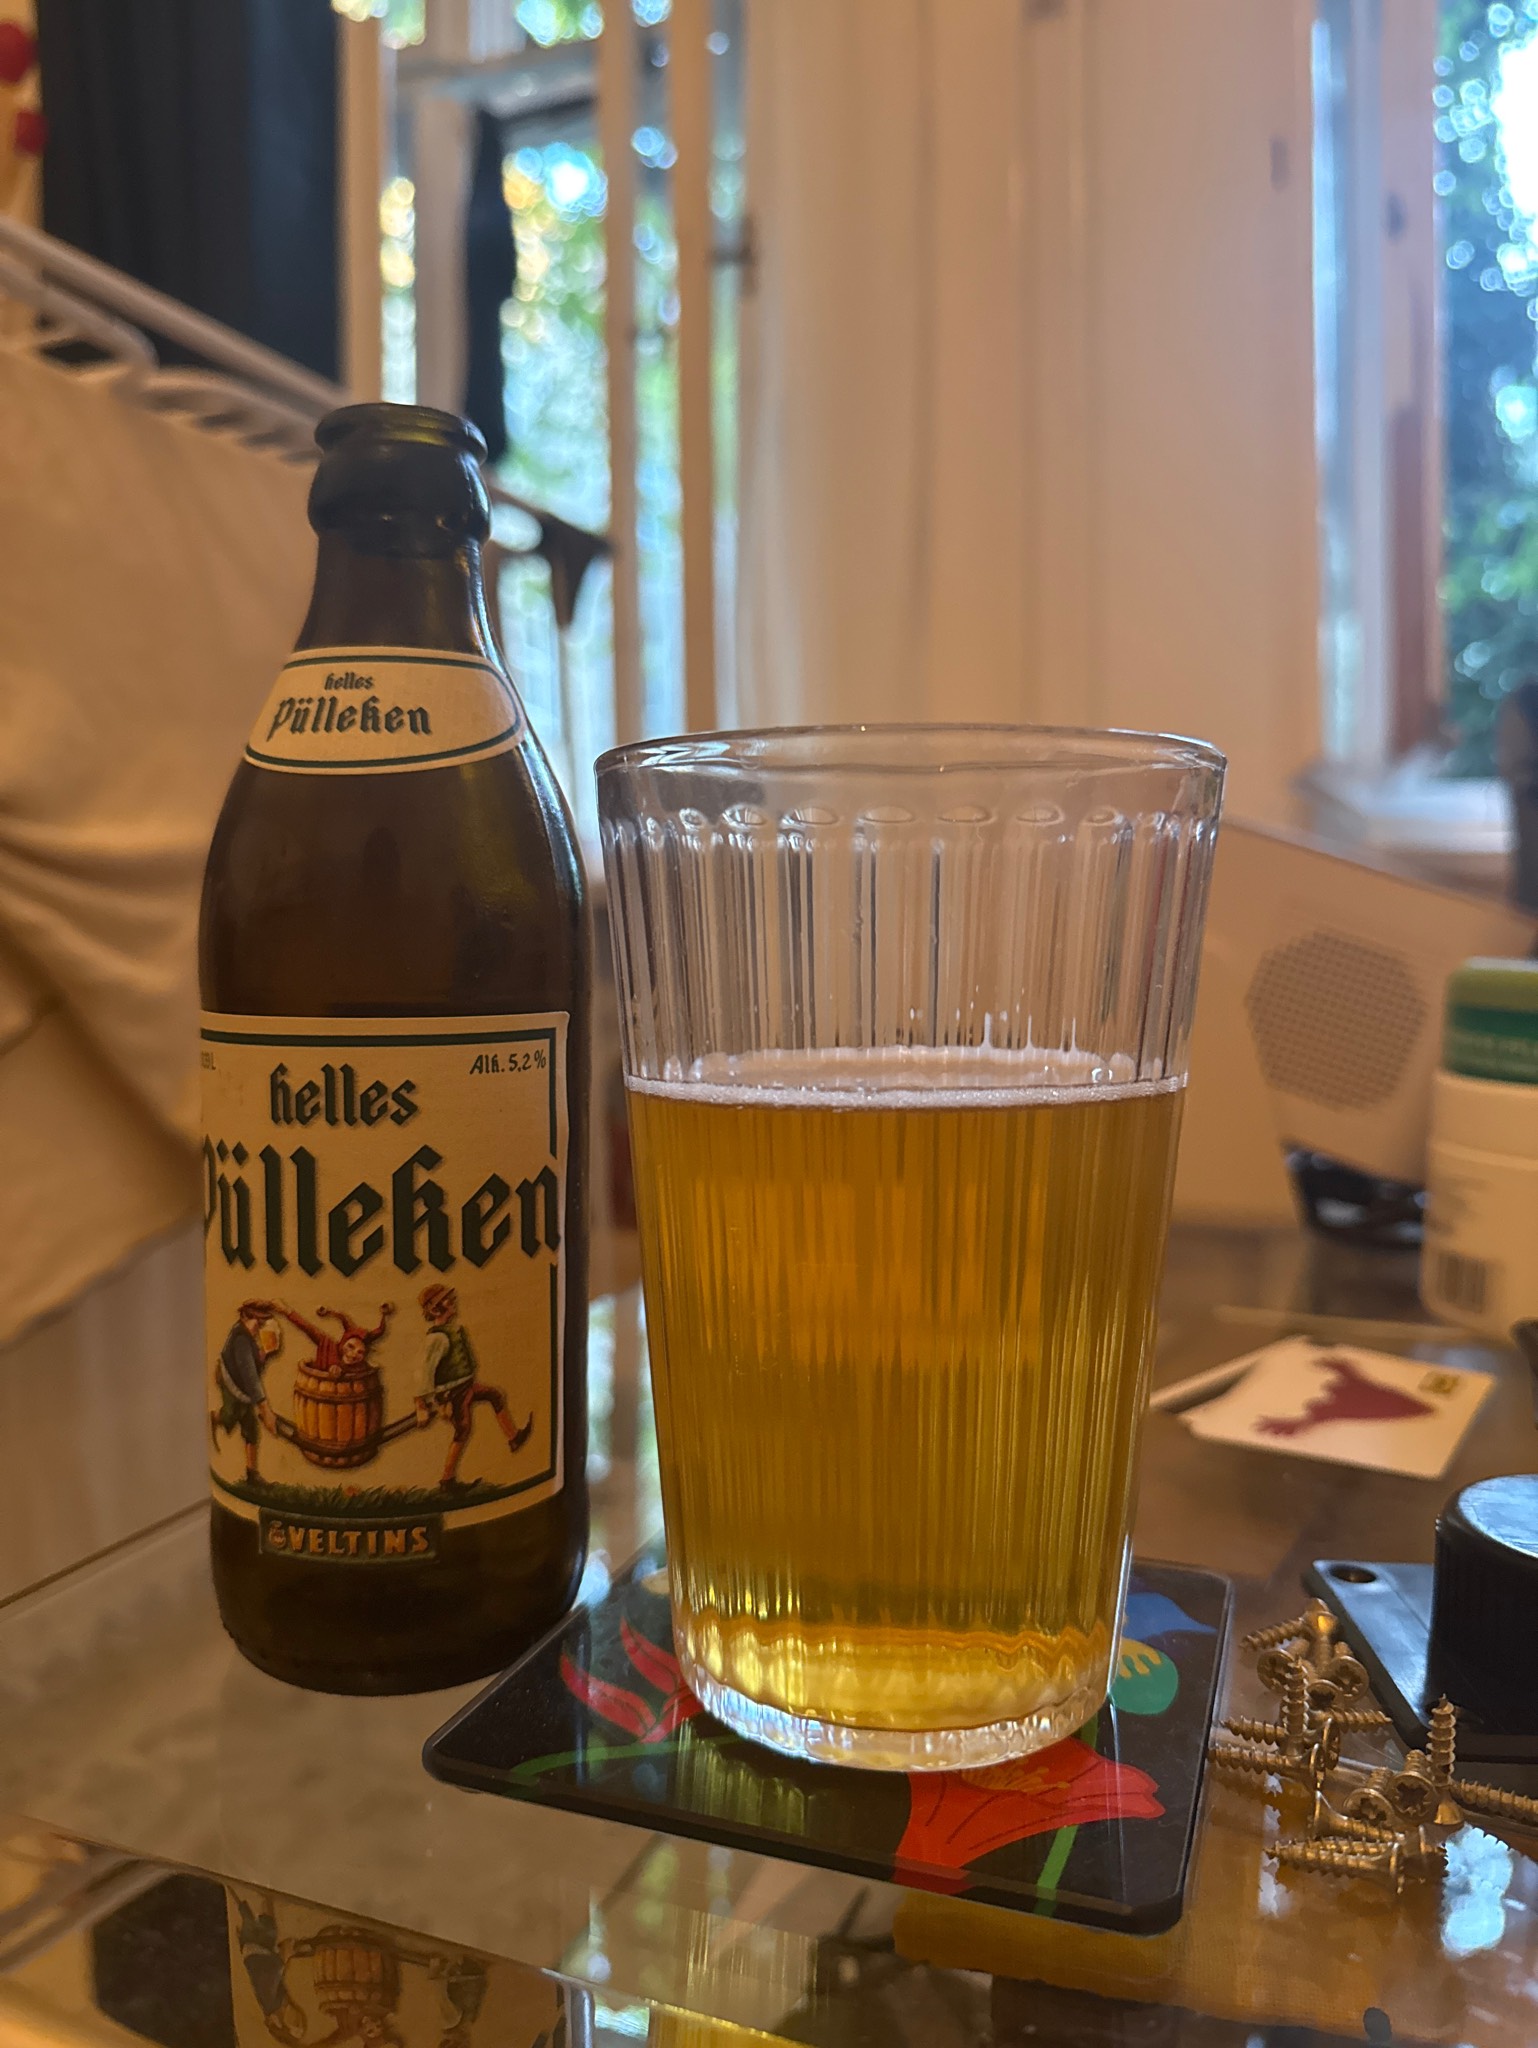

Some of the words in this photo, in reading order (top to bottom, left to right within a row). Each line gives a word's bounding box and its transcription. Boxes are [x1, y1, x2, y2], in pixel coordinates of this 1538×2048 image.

[325, 672, 375, 690] helles
[469, 1053, 505, 1075] Alk.
[270, 1062, 419, 1127] helles
[288, 1525, 429, 1554] VELTINS
